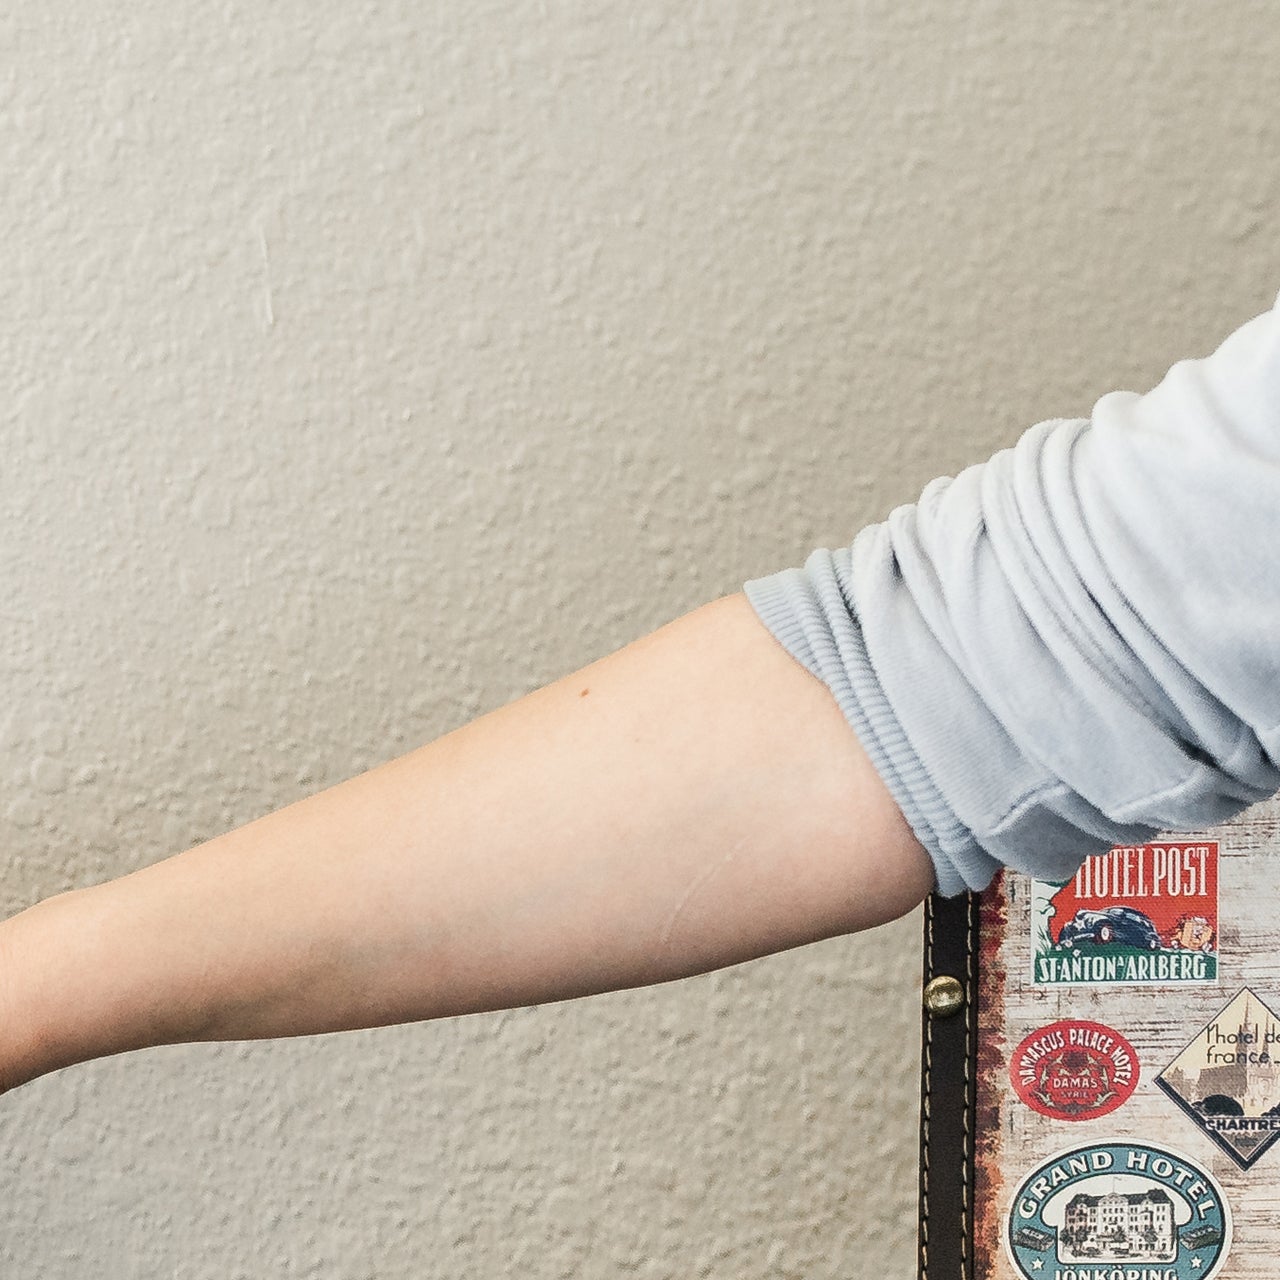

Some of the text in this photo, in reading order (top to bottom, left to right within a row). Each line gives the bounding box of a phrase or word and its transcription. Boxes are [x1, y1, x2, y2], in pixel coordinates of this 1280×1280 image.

[1152, 847, 1209, 897] POST
[1019, 1029, 1132, 1087] DAMASCUS PALACE HOTEL
[1207, 1045, 1270, 1064] france
[1053, 1078, 1098, 1088] DAMAS
[1205, 1119, 1280, 1131] CHARTRE
[1019, 1151, 1114, 1219] GRAND
